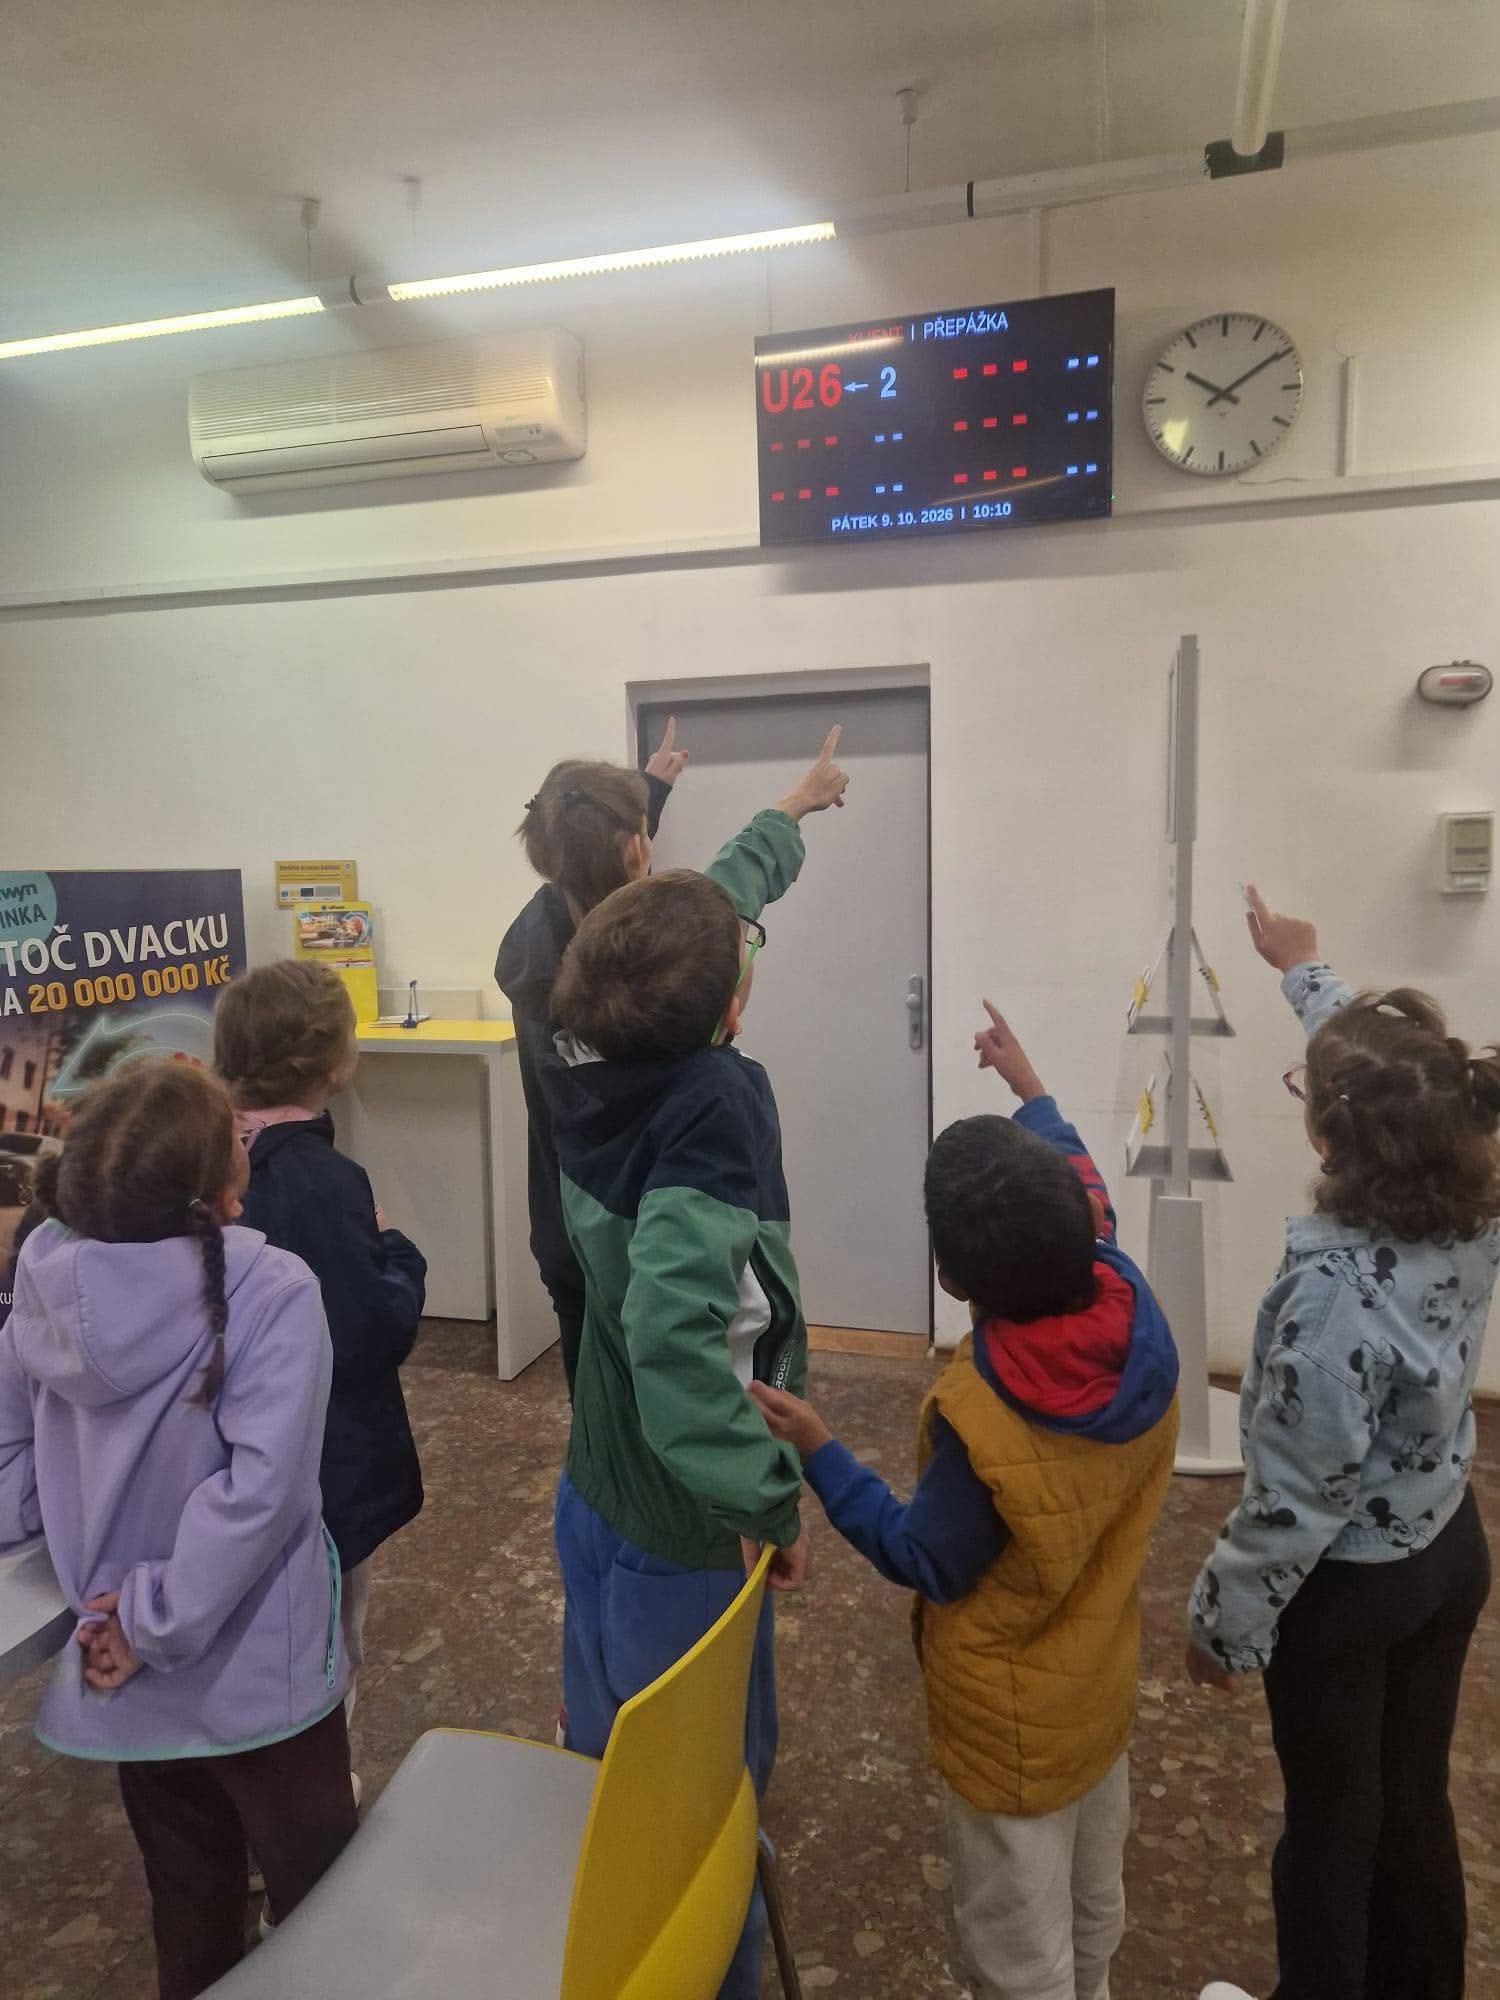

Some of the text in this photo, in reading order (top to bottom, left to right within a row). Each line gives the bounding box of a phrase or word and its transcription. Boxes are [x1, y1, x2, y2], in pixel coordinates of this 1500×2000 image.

[923, 311, 1009, 340] PŘEPÁŽKA
[762, 363, 897, 413] U26 2
[831, 513, 878, 531] PÁTEK
[881, 514, 893, 527] 9.
[897, 512, 916, 526] 10.
[920, 508, 953, 524] 2026
[973, 502, 1012, 519] 10:10
[0, 883, 39, 902] wyn
[0, 903, 47, 929] INKA
[0, 912, 229, 977] TOČ DVACKU
[0, 954, 231, 1017] A 20 000 000 Kč
